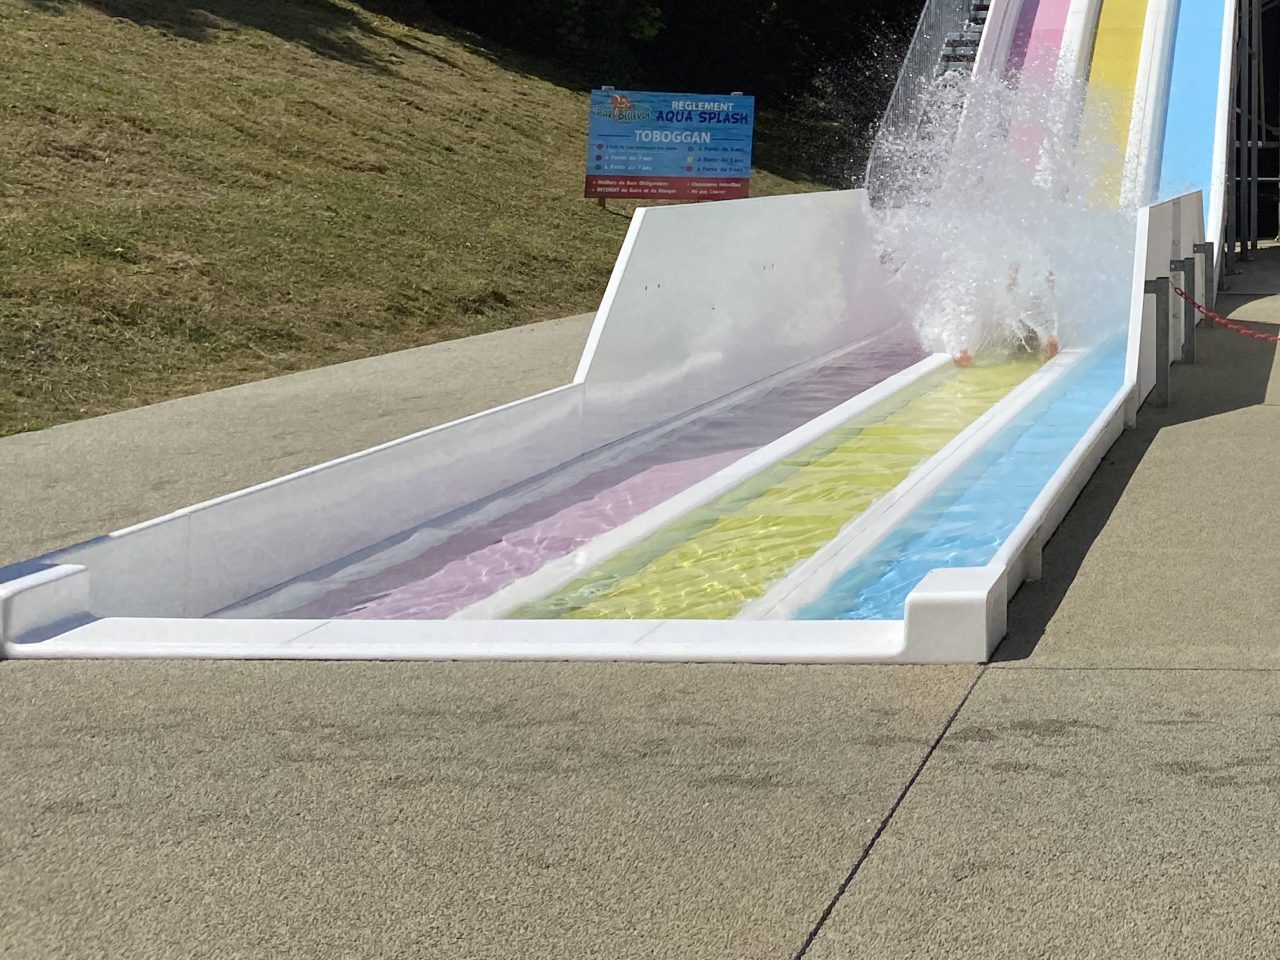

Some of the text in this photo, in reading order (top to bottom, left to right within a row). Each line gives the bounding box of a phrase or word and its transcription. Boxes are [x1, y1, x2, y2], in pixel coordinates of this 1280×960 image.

[656, 110, 748, 124] AQUA SPLASH
[634, 130, 711, 144] TOBOGGAN
